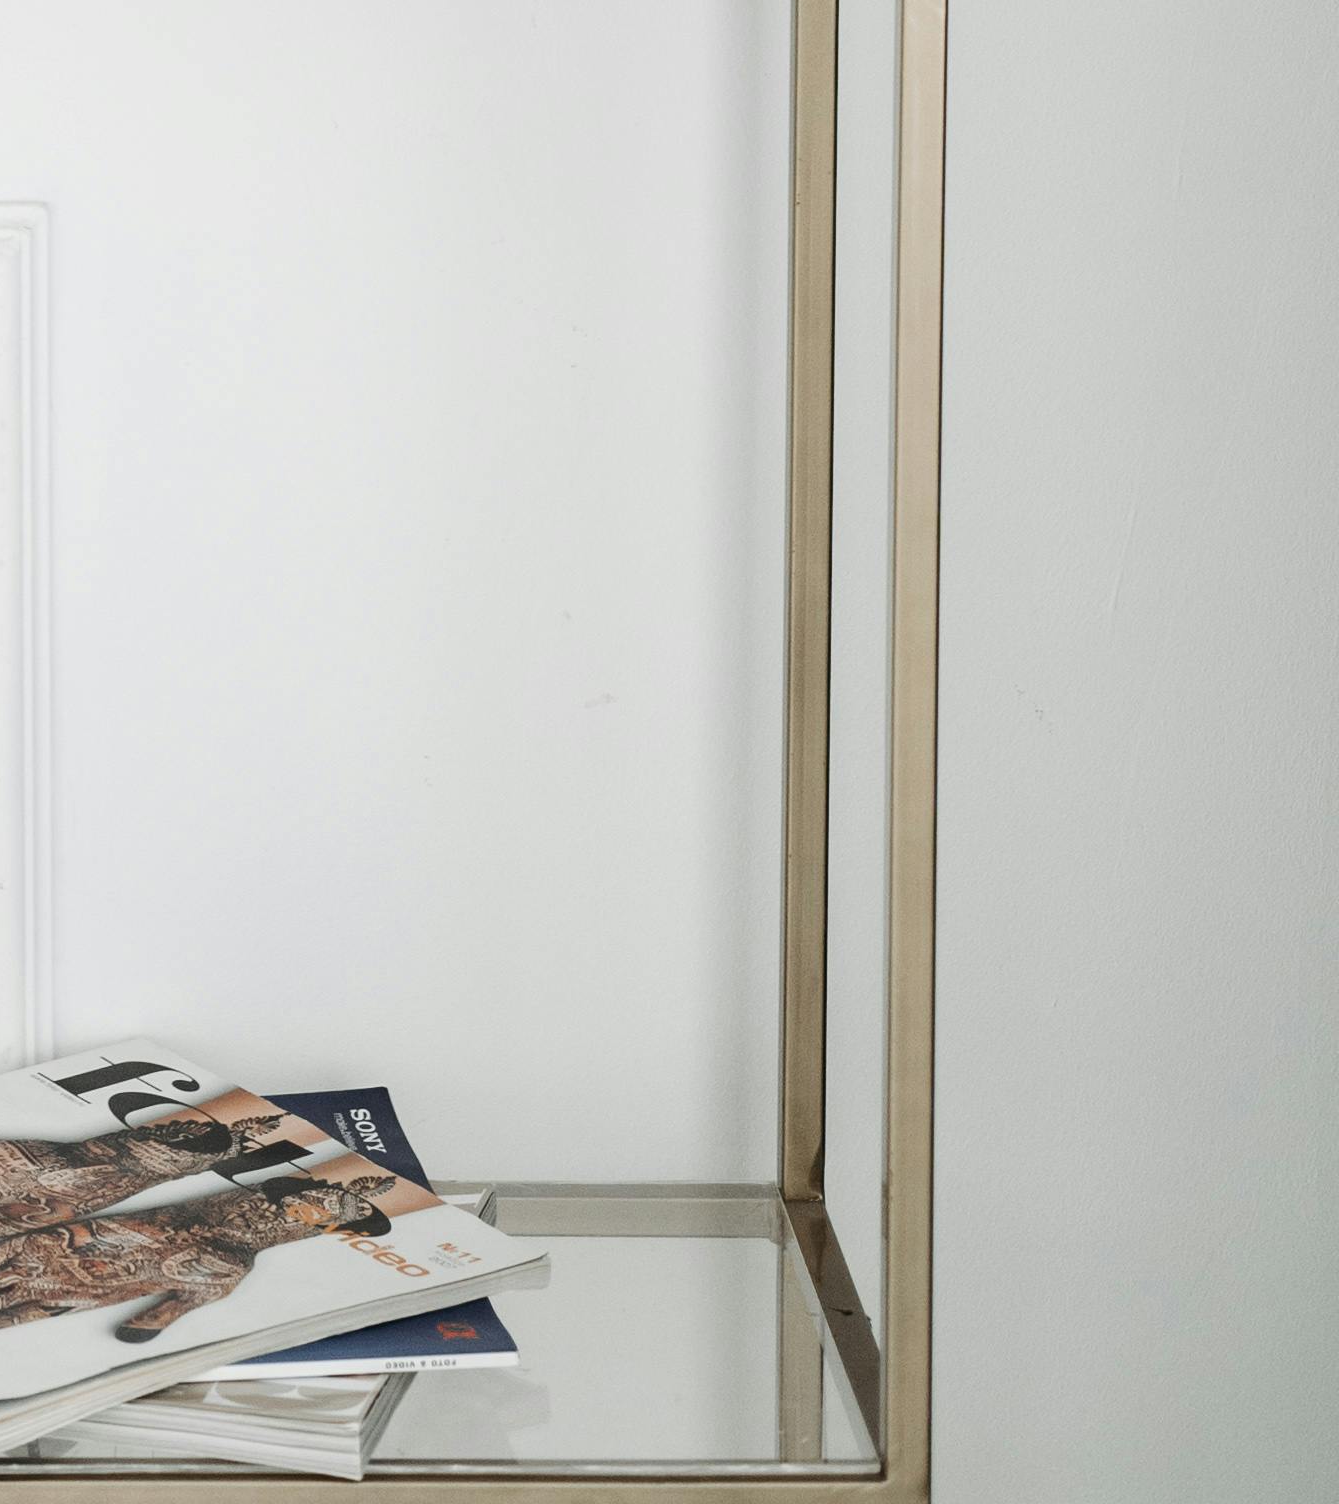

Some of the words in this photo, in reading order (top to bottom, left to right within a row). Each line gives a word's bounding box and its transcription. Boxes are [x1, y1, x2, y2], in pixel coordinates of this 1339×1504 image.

[349, 1107, 387, 1154] SONY
[385, 1361, 416, 1369] VIDEO
[431, 1359, 457, 1367] FOTO
